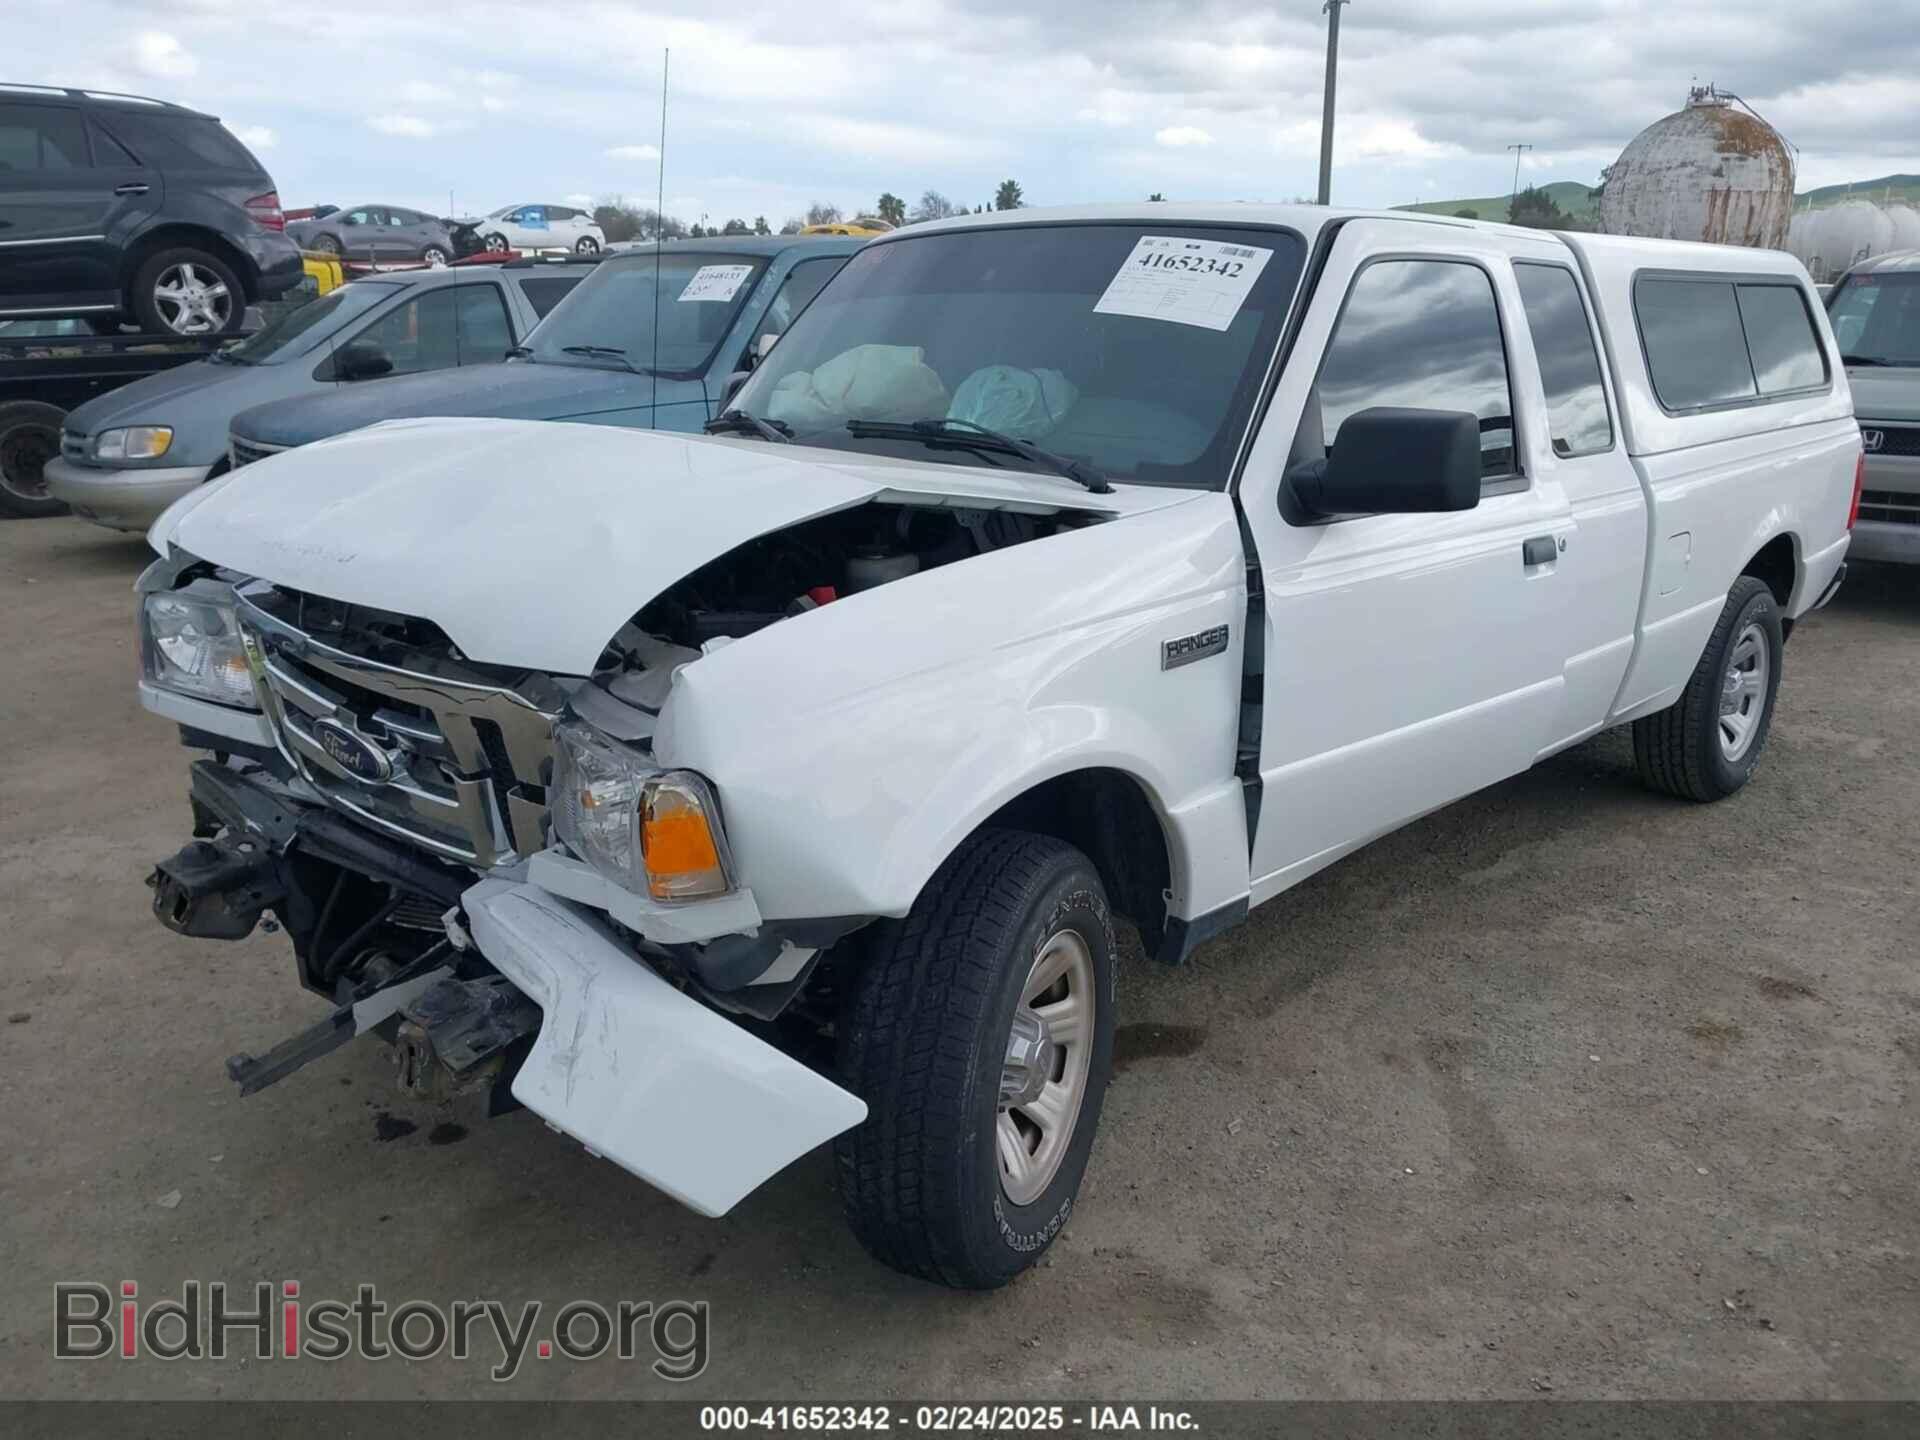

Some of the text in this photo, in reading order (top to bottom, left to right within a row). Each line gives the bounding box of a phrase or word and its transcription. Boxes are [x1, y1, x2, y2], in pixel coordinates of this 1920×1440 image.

[1138, 252, 1244, 278] 41652342
[1166, 626, 1228, 657] RANGER
[321, 729, 363, 769] Ford
